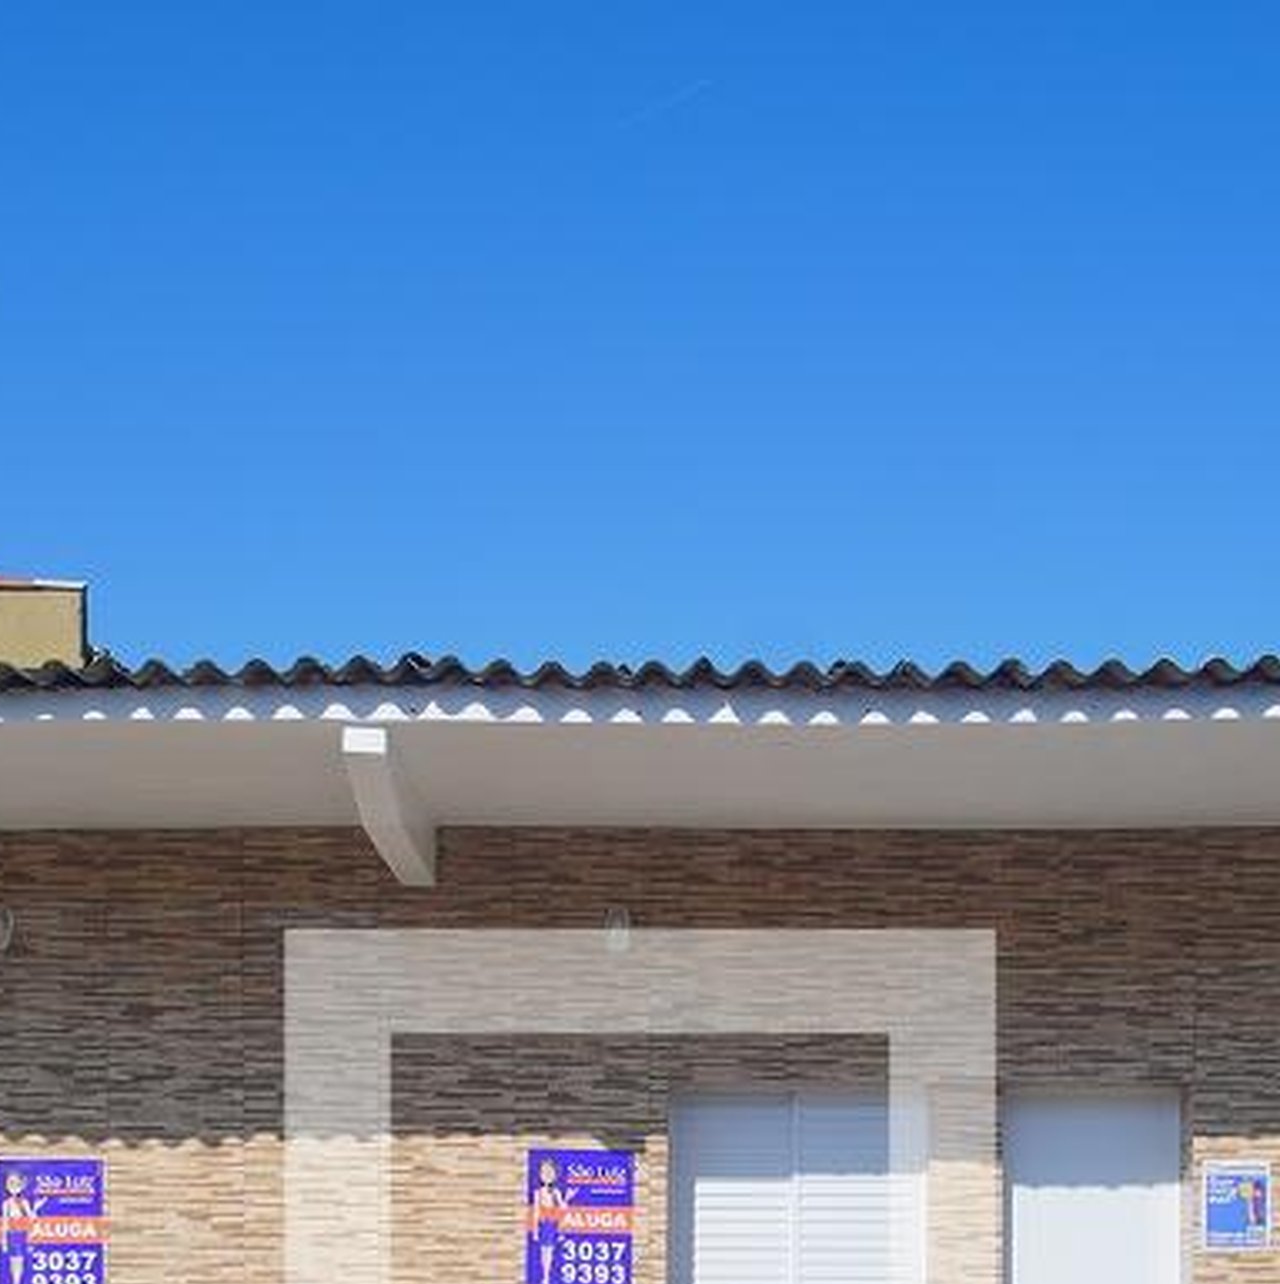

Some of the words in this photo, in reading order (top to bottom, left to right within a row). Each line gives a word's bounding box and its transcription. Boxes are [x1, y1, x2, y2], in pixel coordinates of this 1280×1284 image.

[31, 1223, 97, 1237] ALUGA
[562, 1213, 628, 1227] ALUGA
[562, 1240, 626, 1261] 3037
[32, 1251, 97, 1271] 3037
[561, 1264, 626, 1284] 9393
